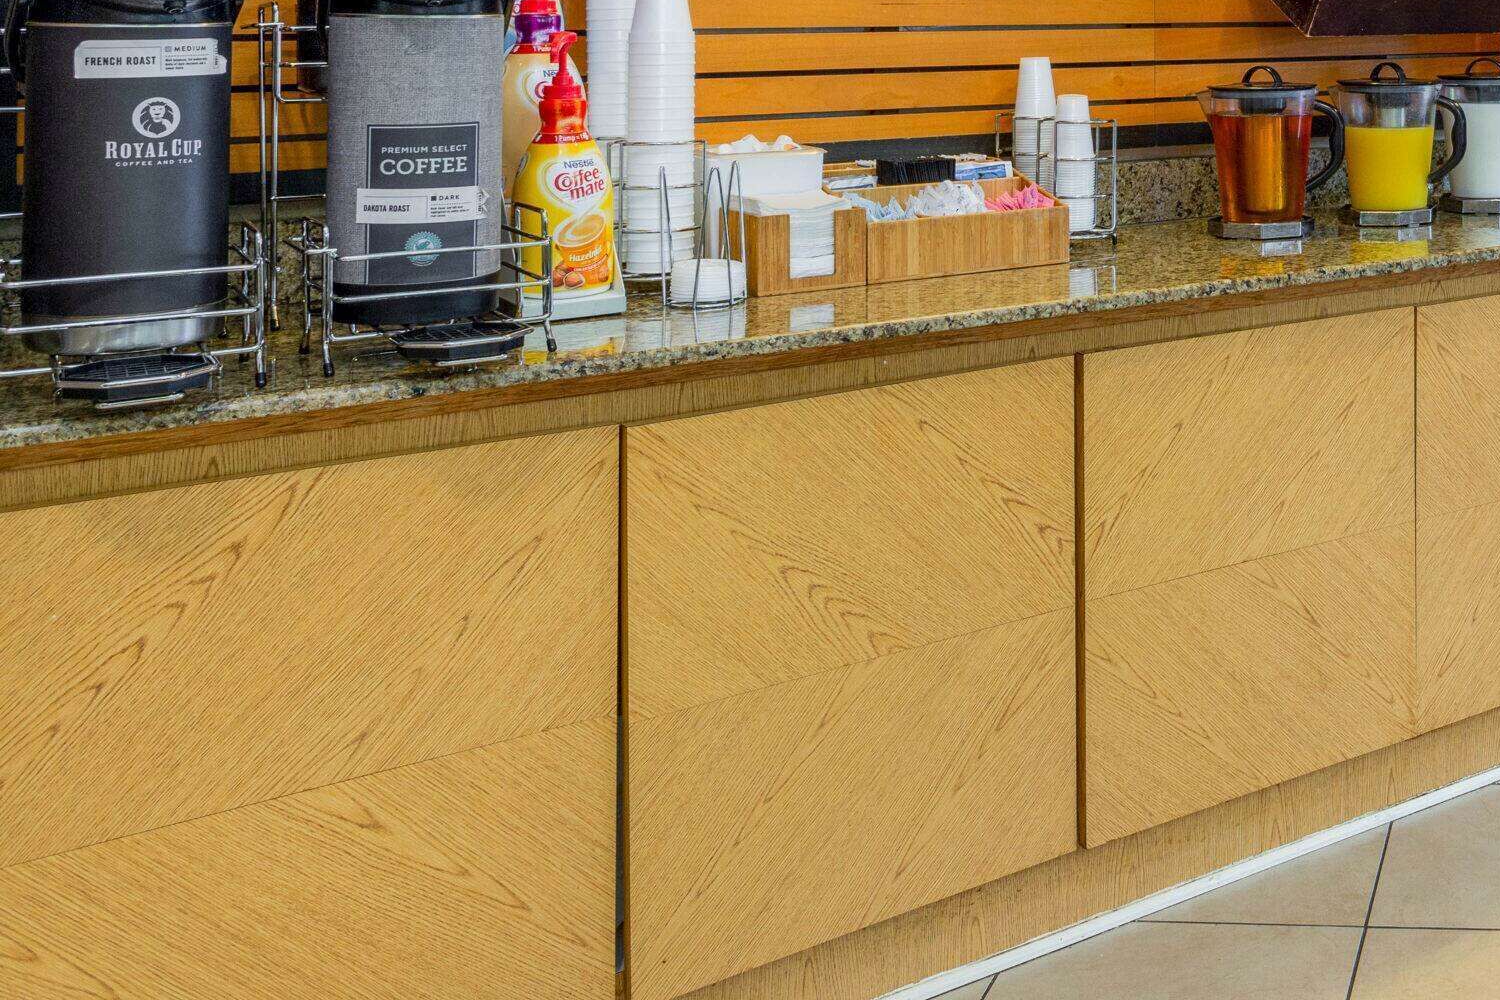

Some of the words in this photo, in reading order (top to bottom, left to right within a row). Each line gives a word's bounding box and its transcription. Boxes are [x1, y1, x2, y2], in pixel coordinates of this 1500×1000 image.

[174, 45, 207, 53] MEDIUM
[85, 56, 122, 66] FRENCH
[126, 56, 157, 65] ROAST
[105, 140, 168, 159] ROYAL
[172, 138, 202, 156] CUP
[381, 145, 429, 154] PREMIUM
[432, 144, 468, 153] SELECT
[380, 156, 468, 176] COFFEE
[570, 179, 605, 201] mate
[438, 194, 460, 202] DARK
[363, 204, 387, 213] DAKOTA
[388, 204, 411, 213] ROAST
